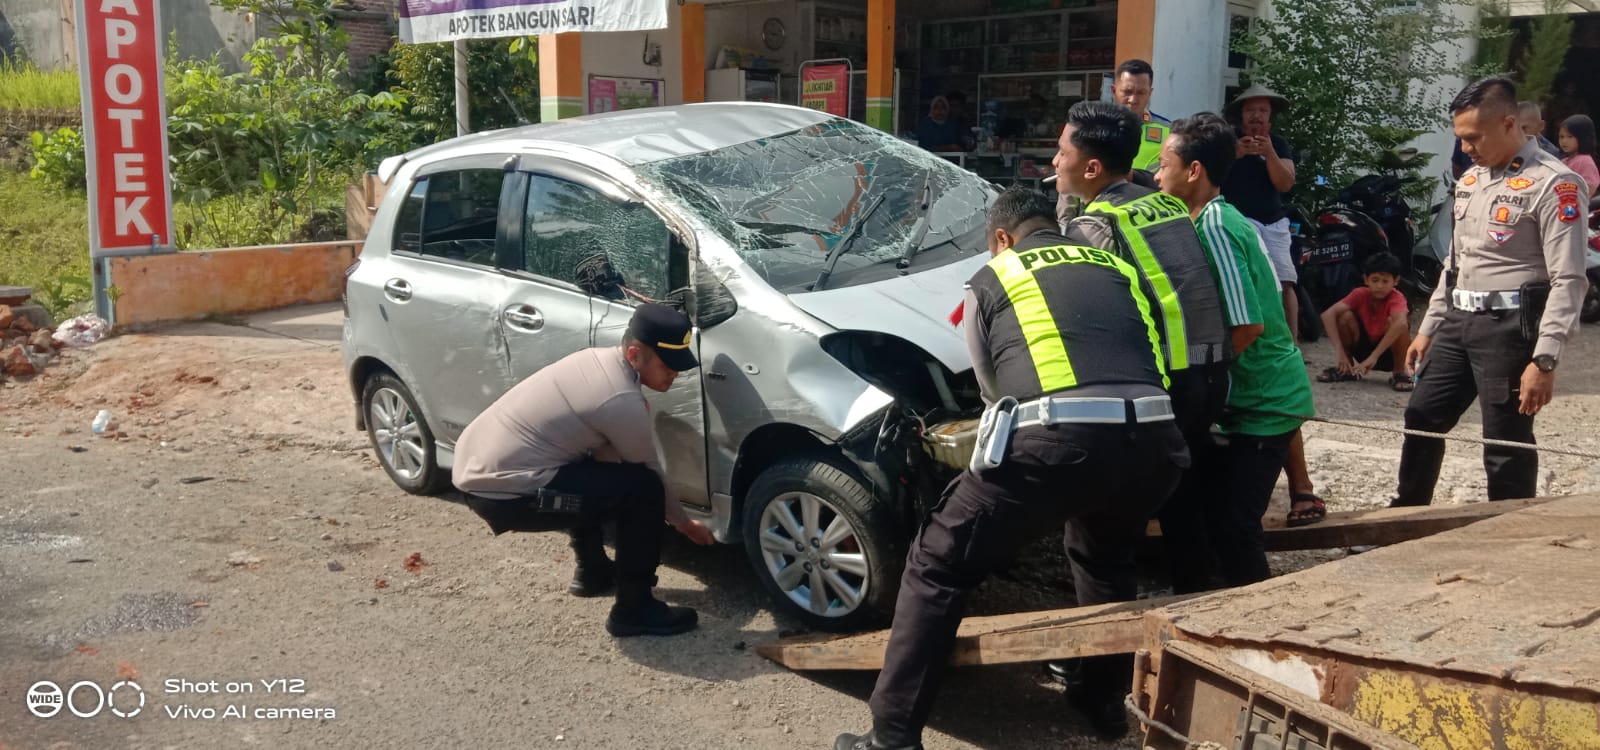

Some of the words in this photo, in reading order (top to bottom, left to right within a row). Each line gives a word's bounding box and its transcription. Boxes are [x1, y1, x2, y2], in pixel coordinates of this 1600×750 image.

[449, 15, 496, 35] APOTEK
[1127, 194, 1189, 226] POLISI
[1495, 195, 1523, 206] POLRI
[1018, 247, 1118, 270] POLISI
